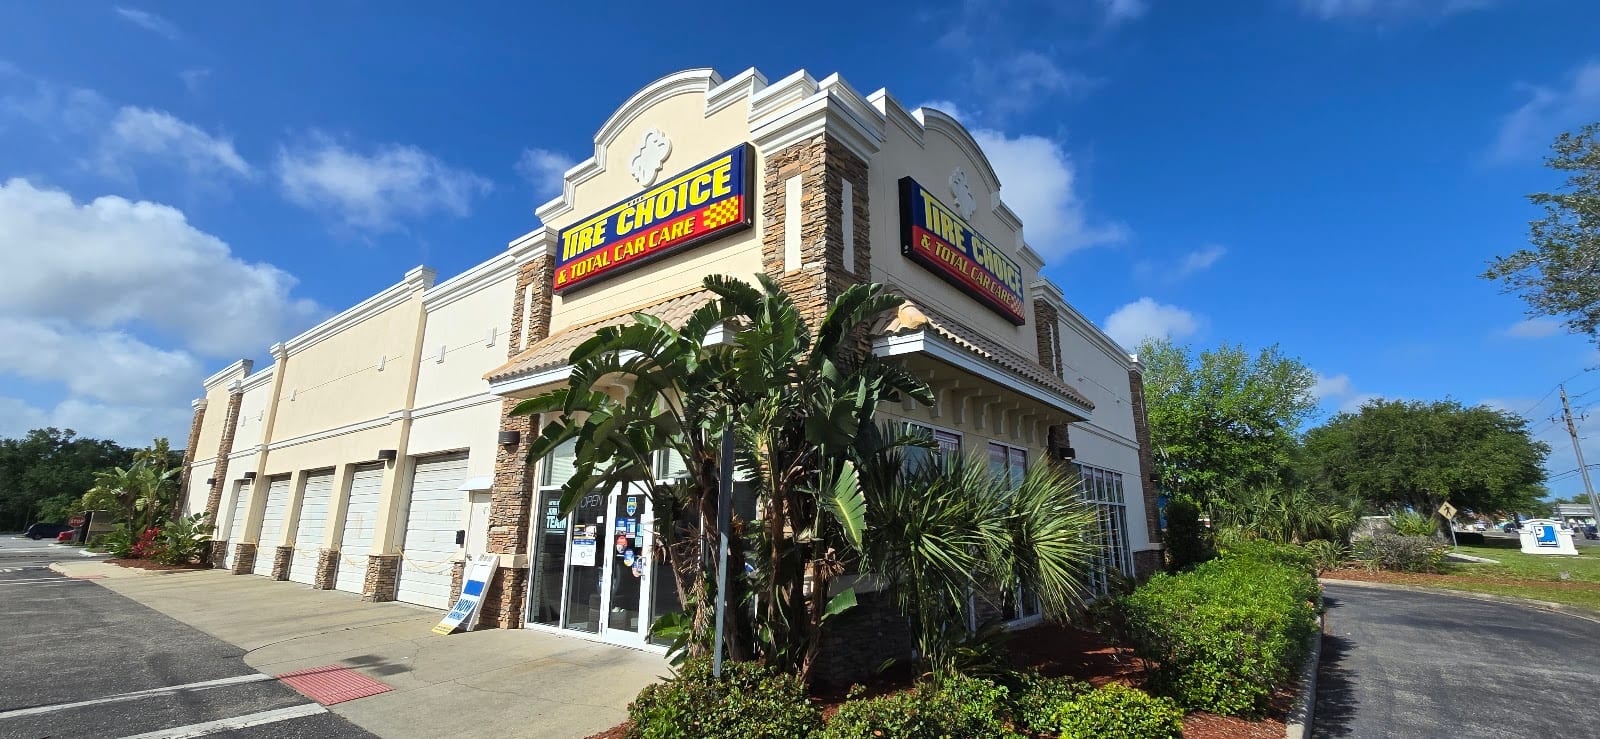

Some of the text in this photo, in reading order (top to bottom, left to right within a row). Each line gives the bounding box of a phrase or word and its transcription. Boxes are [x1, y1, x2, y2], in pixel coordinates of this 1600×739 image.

[562, 164, 731, 262] TIRE CHOICE
[920, 189, 1023, 299] TIRE CHOICE
[557, 216, 696, 285] & TOTAL CAR CARE
[920, 234, 1014, 306] & TOTAL CAR CARE
[580, 494, 604, 508] OPEN
[454, 598, 476, 613] NOW
